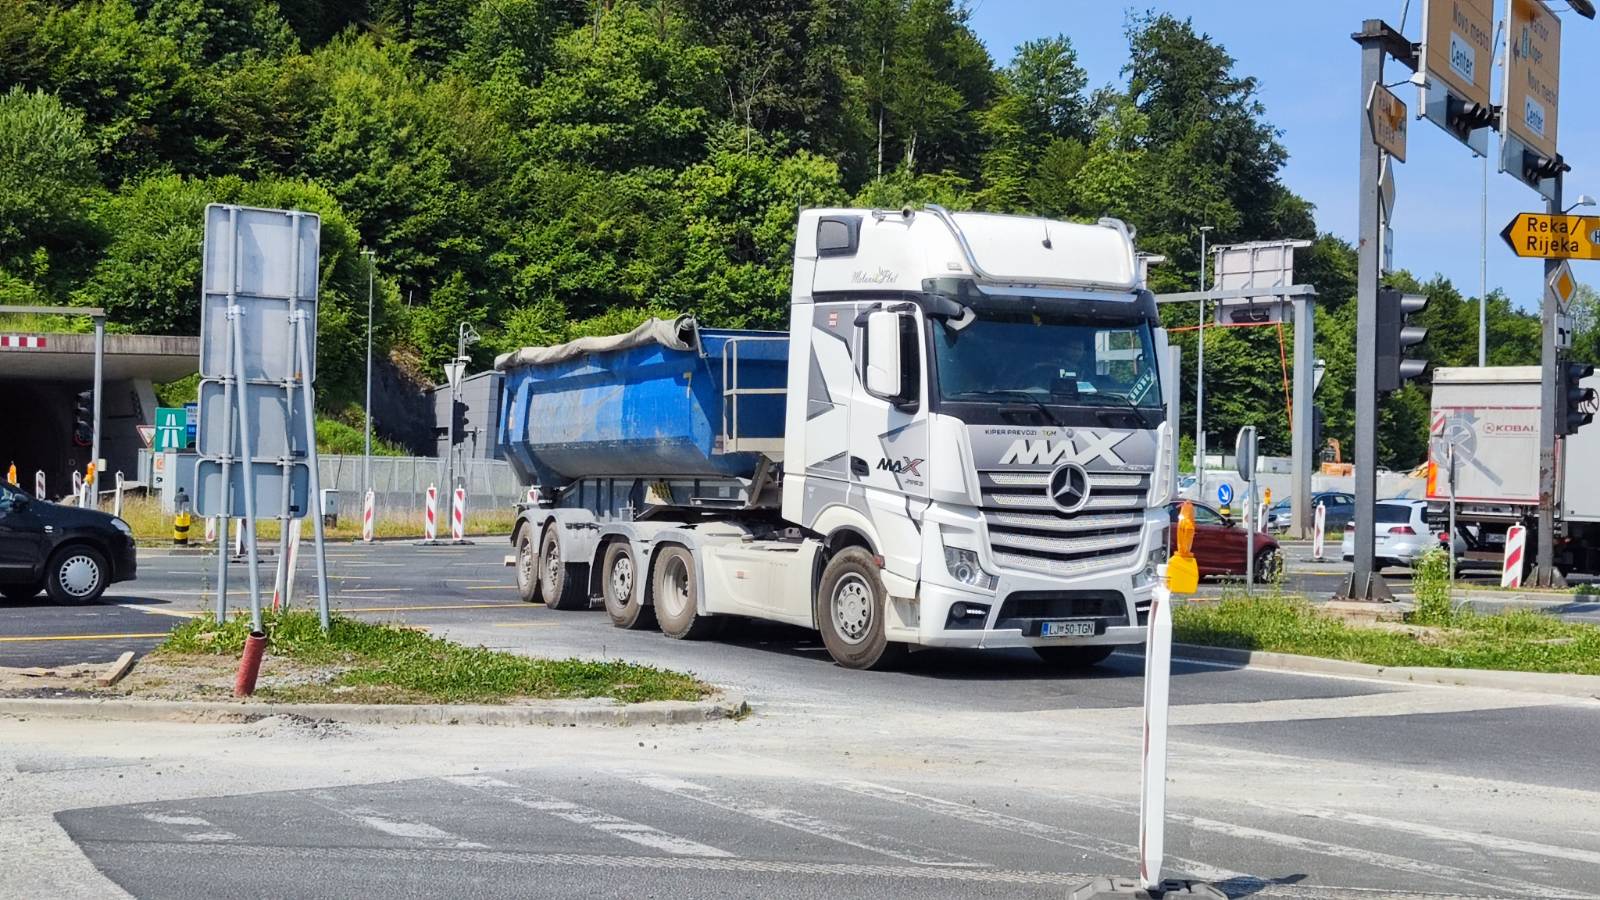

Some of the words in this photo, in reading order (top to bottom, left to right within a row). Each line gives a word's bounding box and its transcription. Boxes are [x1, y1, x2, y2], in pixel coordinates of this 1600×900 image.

[1453, 0, 1468, 34] Novo
[1470, 23, 1489, 51] mesto
[1452, 40, 1473, 76] Center
[1527, 102, 1544, 131] Center
[1527, 217, 1582, 236] Reka/
[1527, 236, 1579, 255] Rijeka
[998, 430, 1136, 466] MAX
[876, 456, 925, 477] MAX
